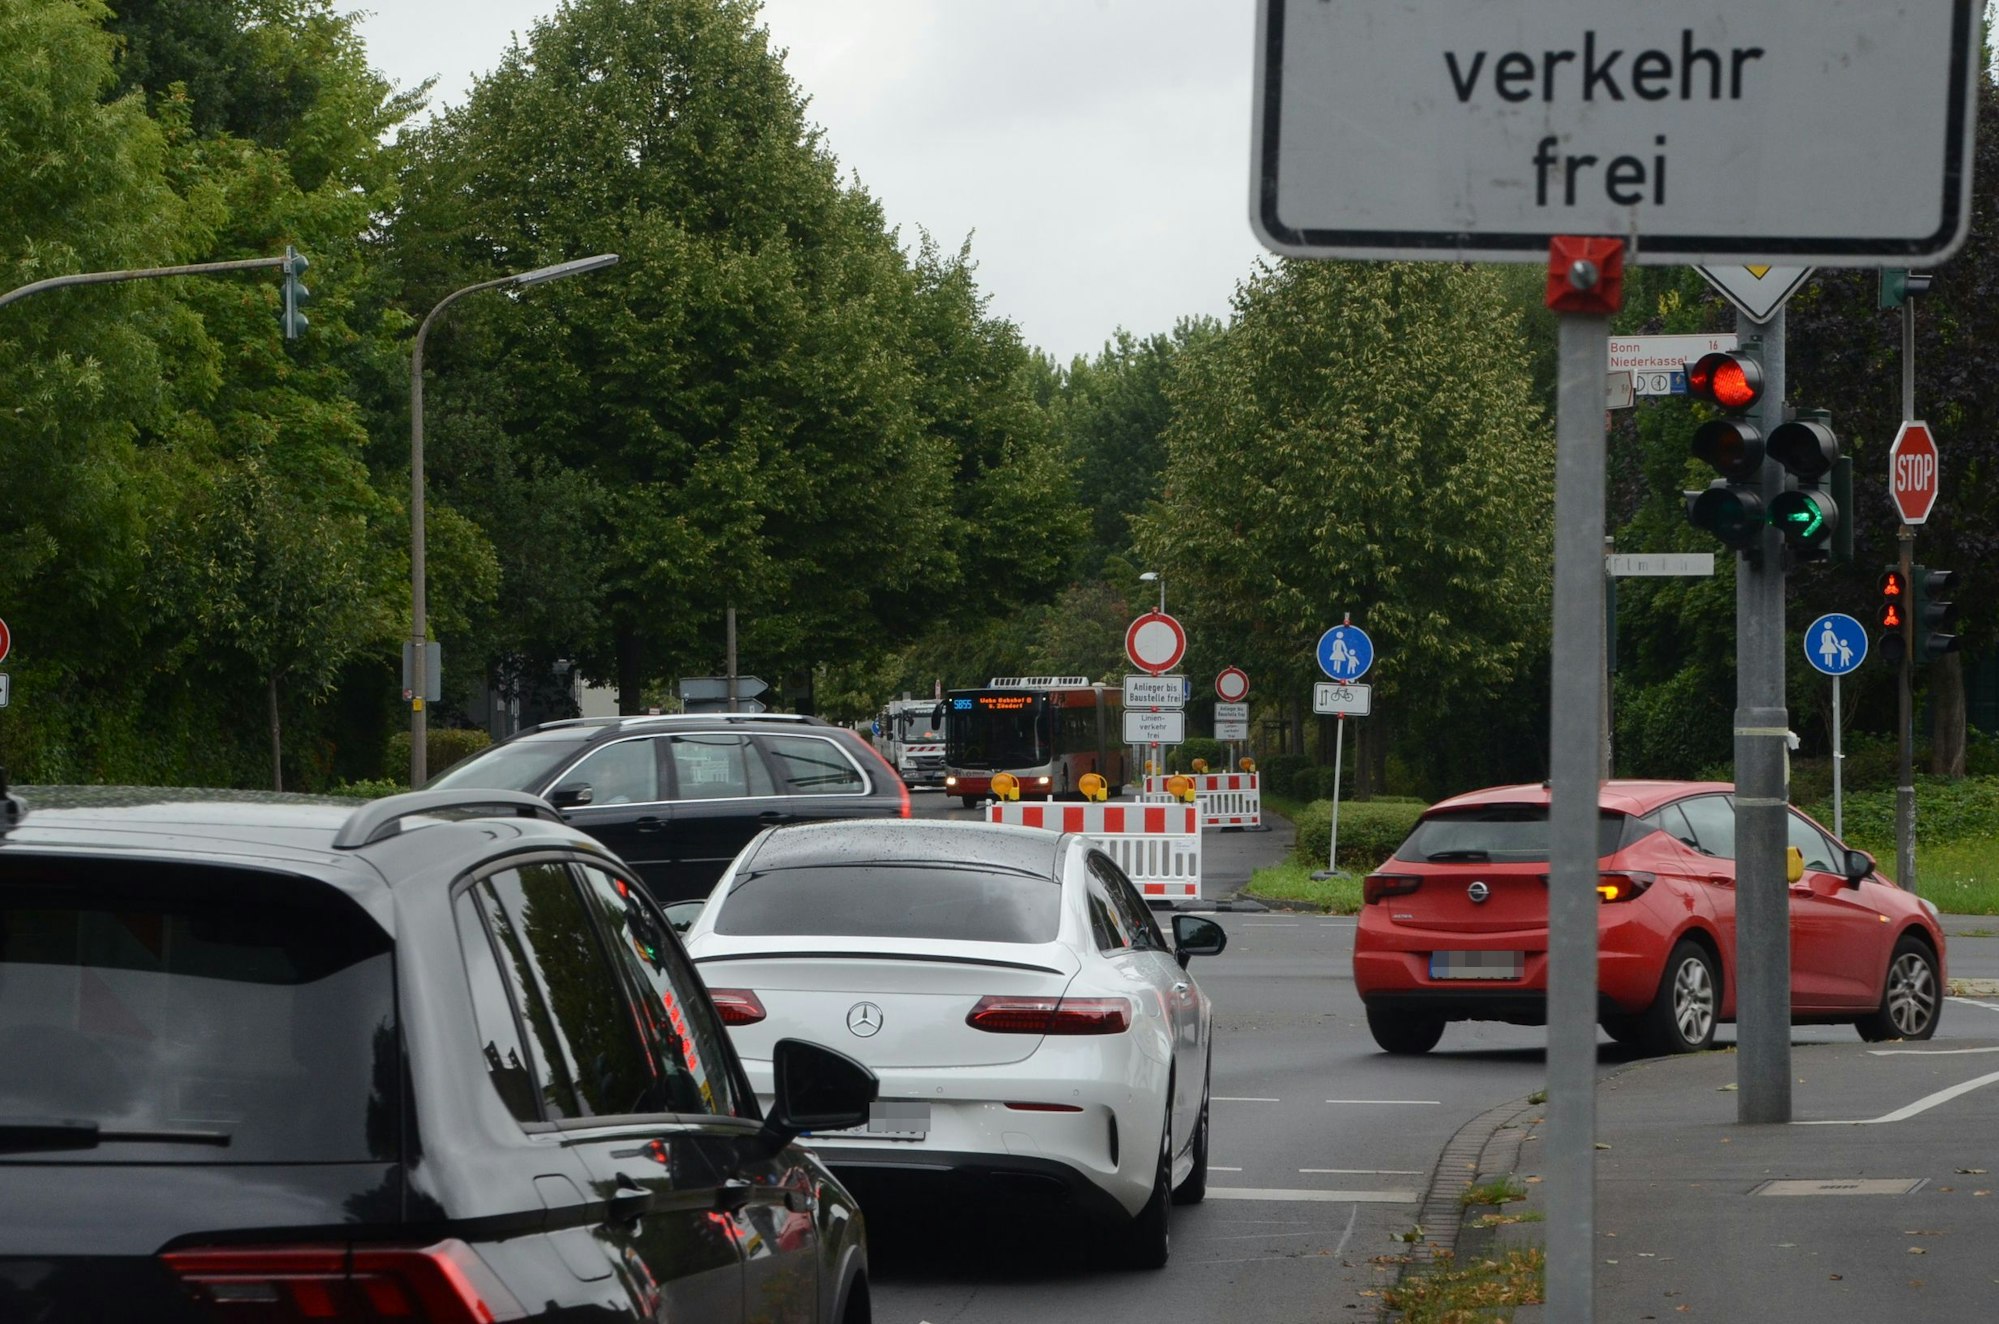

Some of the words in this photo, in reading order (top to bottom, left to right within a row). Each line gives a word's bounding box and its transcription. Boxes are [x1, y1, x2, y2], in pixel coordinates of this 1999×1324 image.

[1444, 29, 1765, 102] verkehr
[1533, 134, 1666, 206] frei
[1610, 342, 1640, 353] Bonn
[1708, 340, 1718, 351] 16
[1896, 453, 1933, 492] STOP
[1134, 683, 1164, 693] Anlieger
[1167, 684, 1177, 692] bis
[1130, 693, 1165, 702] Baustelle
[1167, 693, 1181, 702] frei
[1141, 714, 1166, 722] Linien-
[1147, 731, 1160, 739] frei
